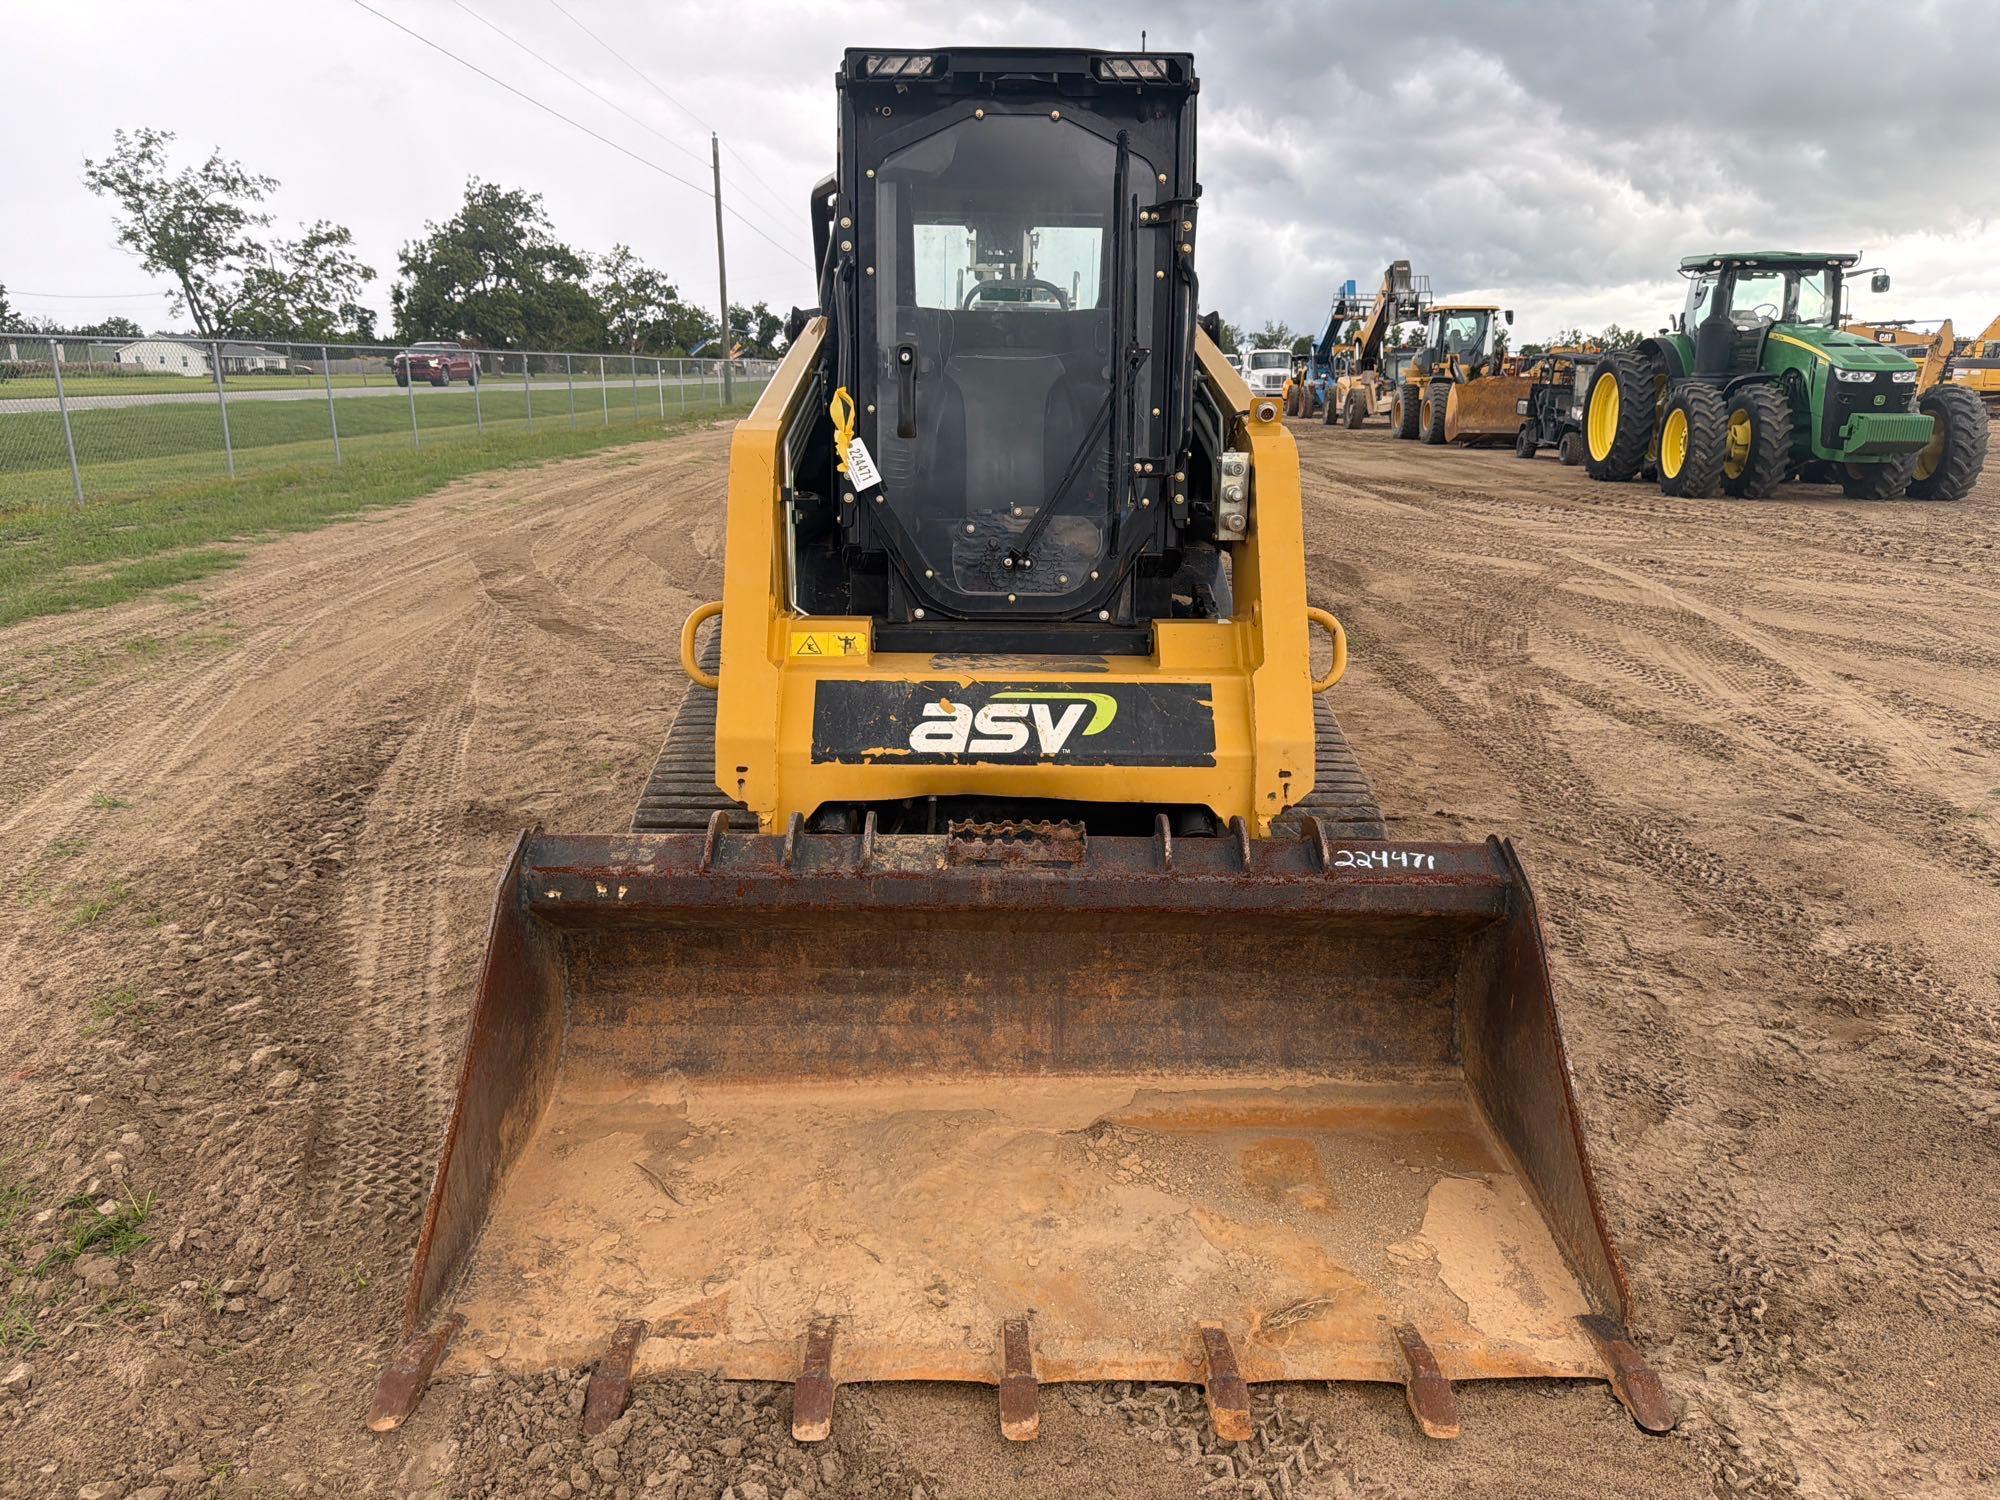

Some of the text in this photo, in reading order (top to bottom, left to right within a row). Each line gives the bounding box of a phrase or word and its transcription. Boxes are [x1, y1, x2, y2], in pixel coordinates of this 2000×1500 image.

[1879, 333, 1892, 342] CAT
[849, 448, 873, 482] 224471
[1334, 850, 1435, 870] 224471
